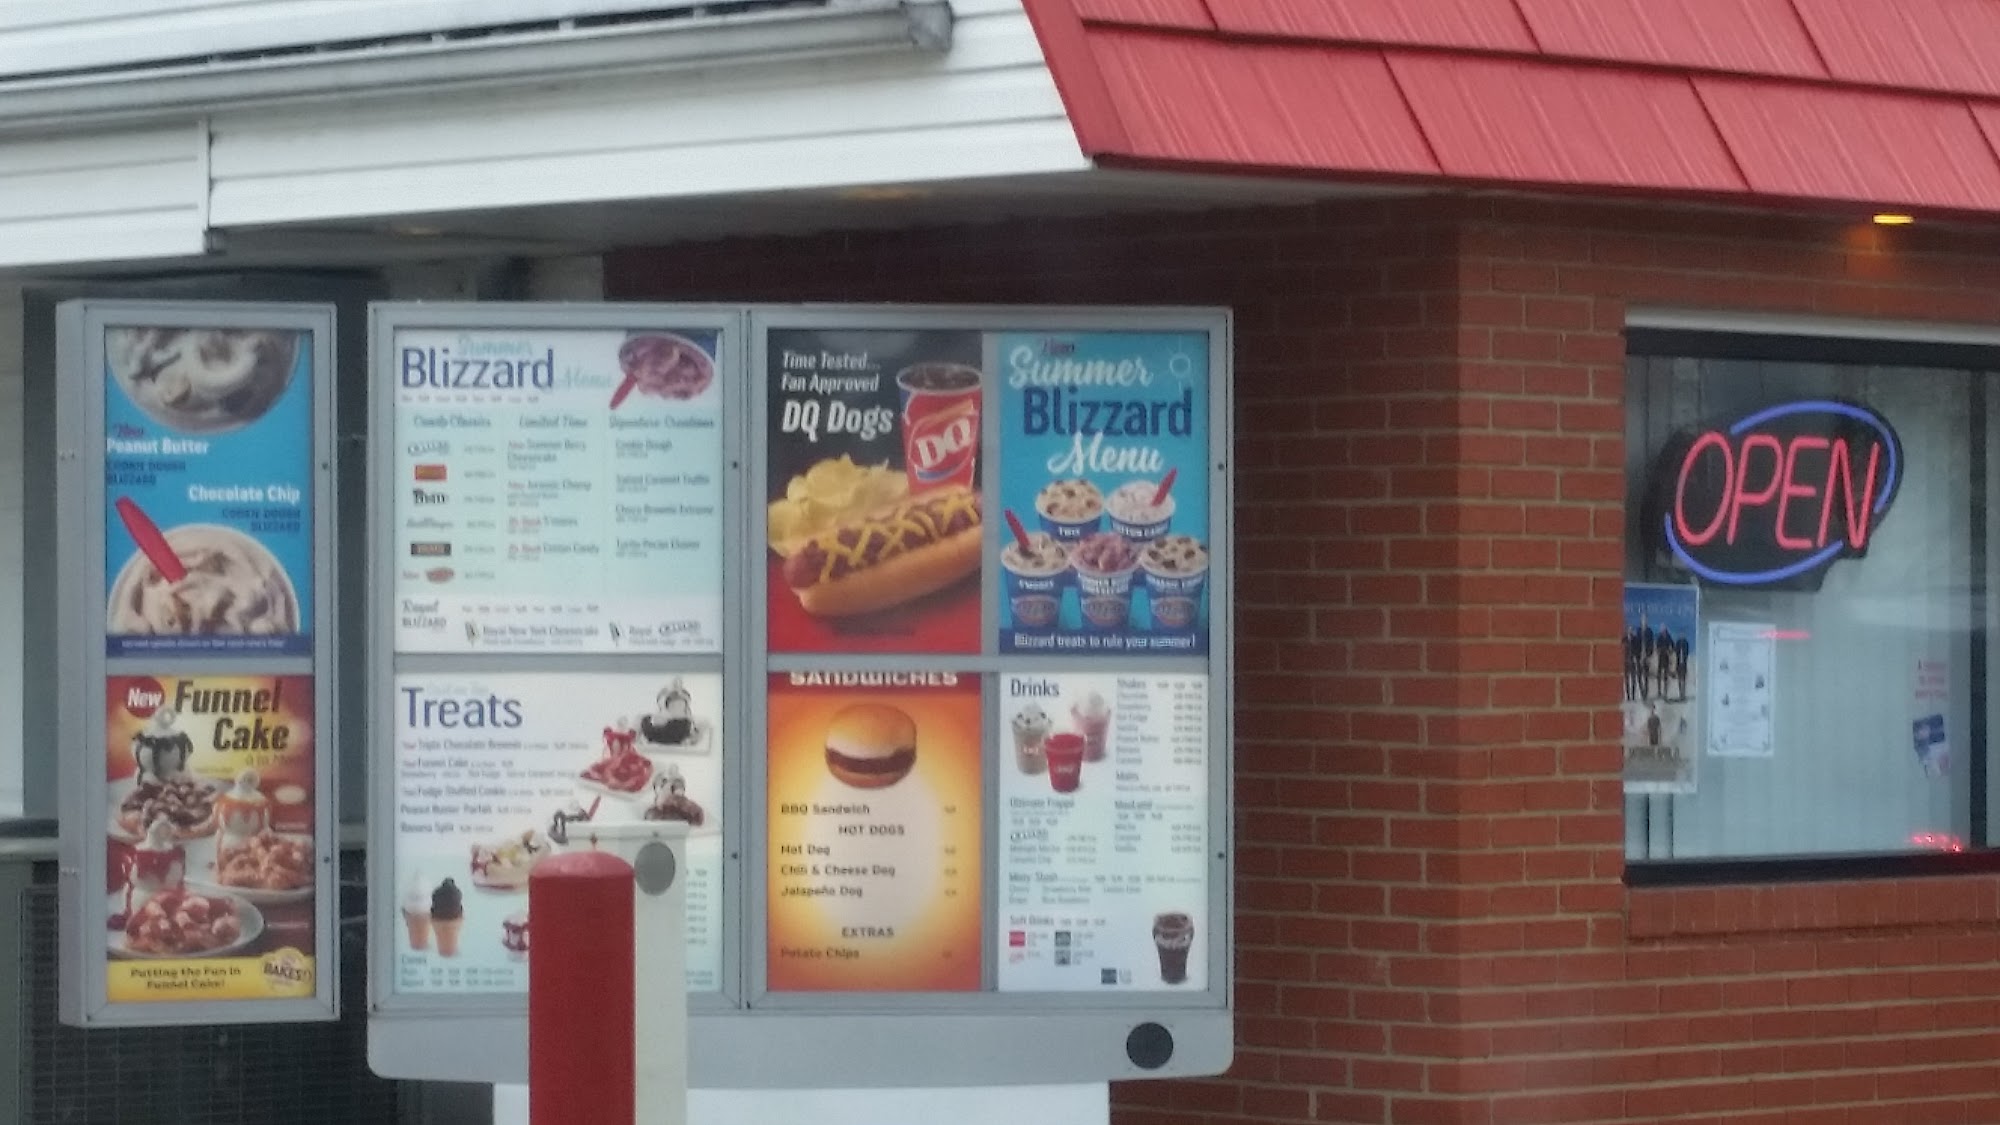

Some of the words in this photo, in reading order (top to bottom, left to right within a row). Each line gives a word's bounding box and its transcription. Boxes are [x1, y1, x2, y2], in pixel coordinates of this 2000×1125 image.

[402, 348, 554, 389] Blizzard
[783, 351, 816, 369] Time
[1008, 345, 1154, 389] Summer
[781, 373, 806, 391] Fan
[809, 372, 880, 395] Approved
[1023, 386, 1192, 436] Blizzard
[782, 399, 820, 442] DQ
[826, 400, 894, 441] Dogs
[107, 438, 158, 454] Peanut
[162, 438, 209, 454] Butter
[915, 418, 971, 468] DQ
[1047, 431, 1164, 476] Menu
[188, 485, 263, 501] Chocolate
[268, 485, 300, 505] Chip
[1674, 431, 1880, 550] OPEN
[1014, 633, 1054, 647] Blizzard
[1057, 633, 1087, 647] treats
[1089, 634, 1100, 647] to
[1103, 633, 1123, 647] rule
[1126, 637, 1147, 649] your
[790, 671, 958, 686] SANDWICHES
[1010, 678, 1060, 697] Drinks
[127, 688, 163, 708] New
[175, 681, 283, 714] Funnel
[402, 687, 523, 728] Treats
[213, 718, 290, 751] Cake
[781, 804, 808, 815] BBQ
[812, 804, 870, 814] Sandwich
[838, 825, 864, 835] HOT
[870, 825, 905, 835] DOGS
[781, 845, 803, 855] Hot
[807, 845, 831, 857] Dog
[781, 865, 808, 876] Chili
[811, 866, 820, 876] &
[824, 865, 868, 876] Cheese
[872, 866, 896, 878] Dog
[840, 886, 863, 898] Dog
[841, 927, 895, 938] EXTRAS
[781, 949, 822, 959] Potato
[826, 948, 860, 960] Chips
[131, 967, 178, 980] Putting
[181, 966, 201, 977] the
[204, 967, 227, 977] Fun
[230, 967, 242, 977] in
[147, 979, 188, 990] Funnel
